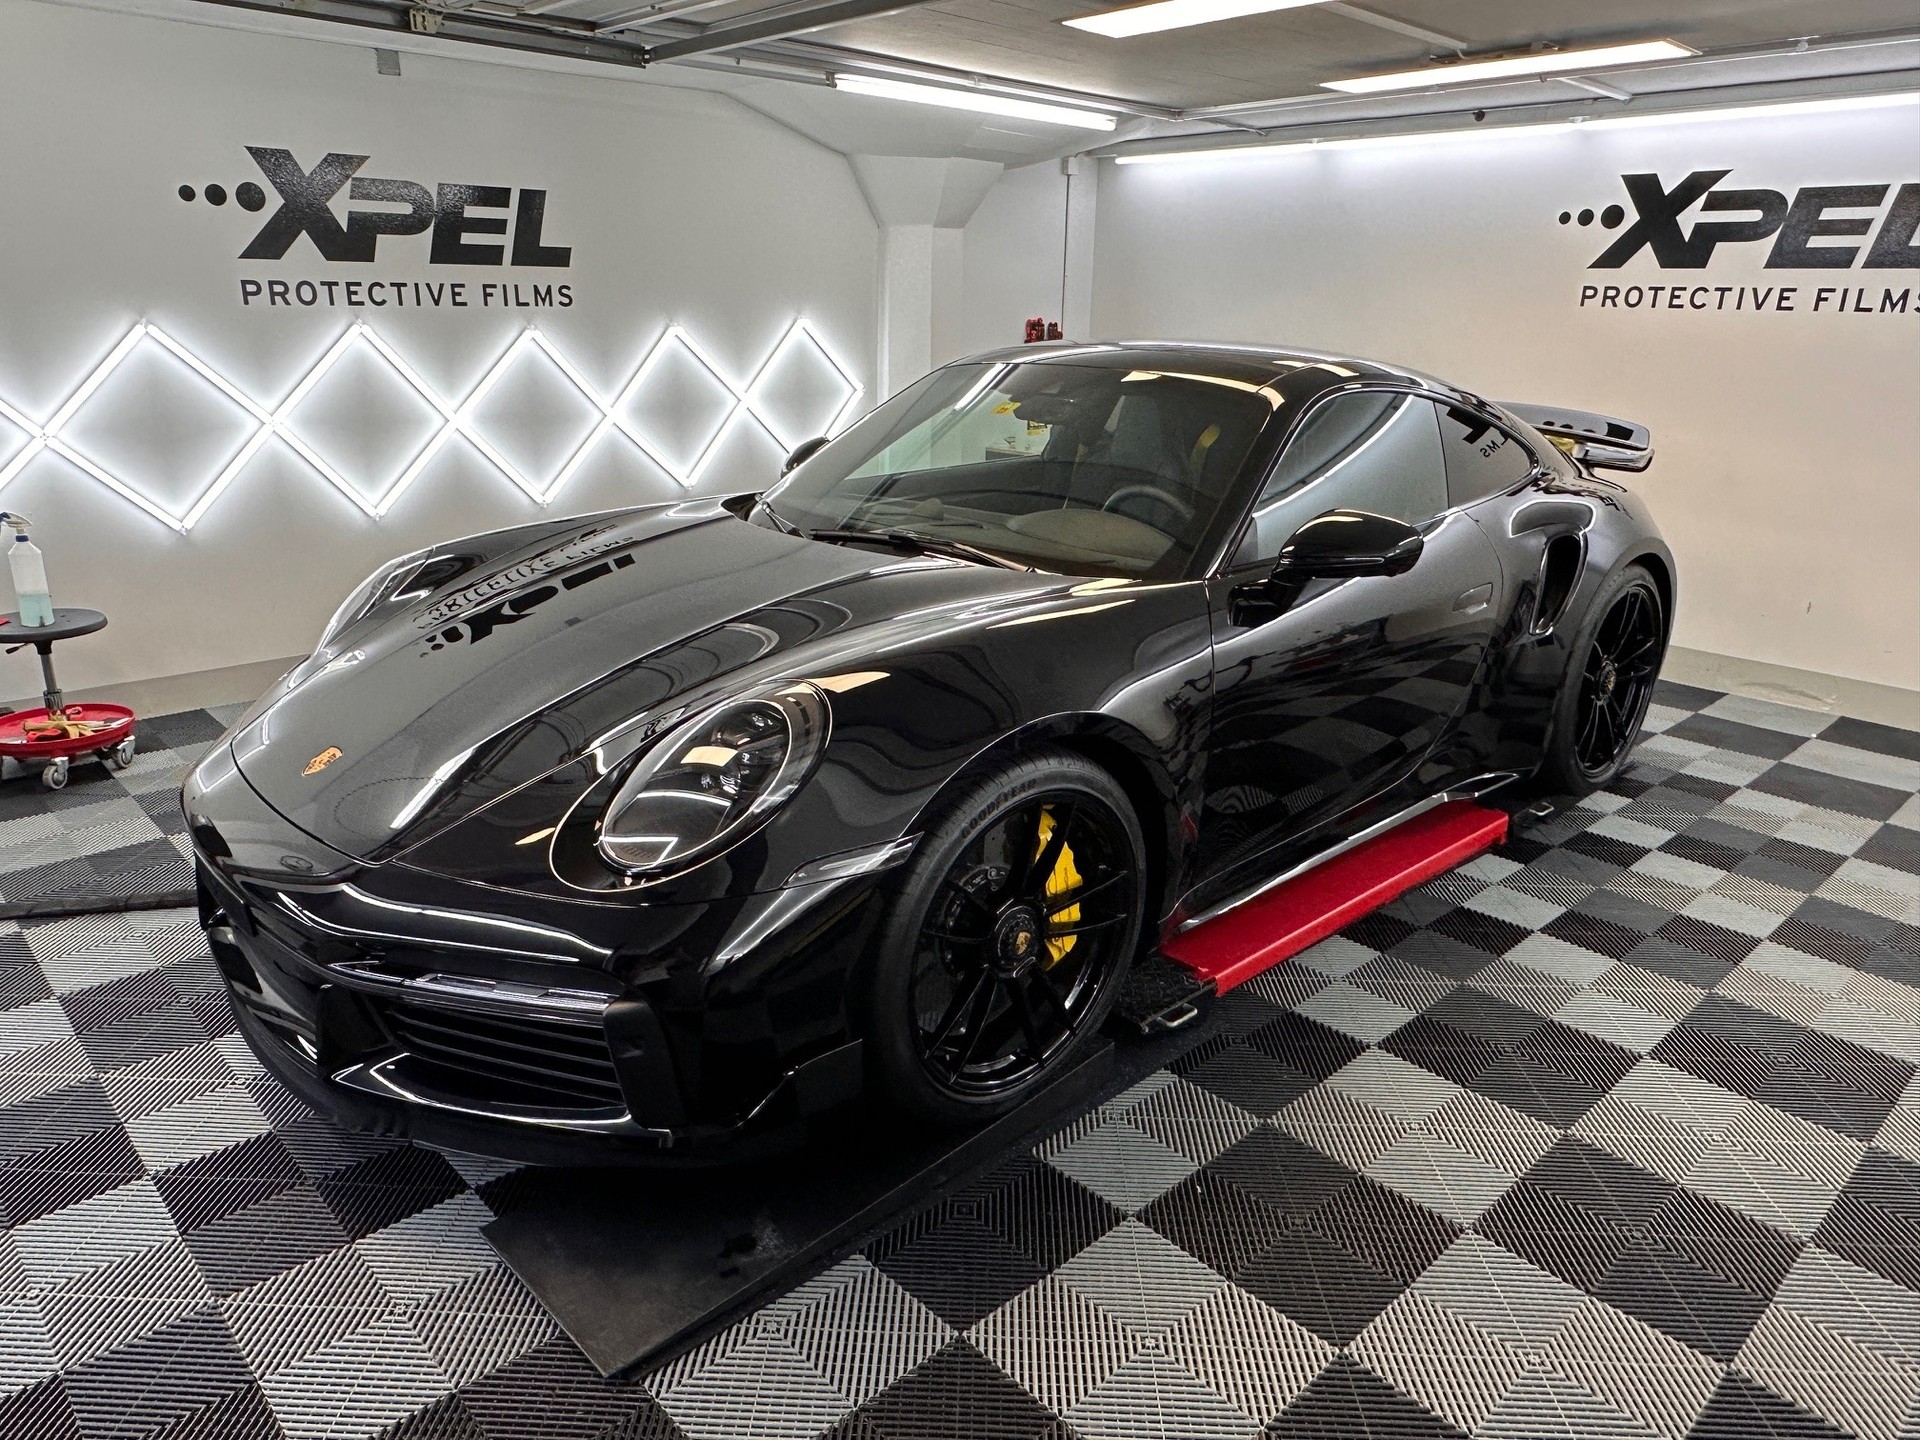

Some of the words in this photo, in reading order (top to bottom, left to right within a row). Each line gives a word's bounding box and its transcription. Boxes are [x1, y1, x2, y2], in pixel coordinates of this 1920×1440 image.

[237, 146, 572, 267] XPEL
[241, 280, 468, 307] PROTECTIVE
[483, 284, 573, 307] FILMS
[1580, 286, 1797, 312] PROTECTIVE
[1813, 288, 1920, 313] FILM
